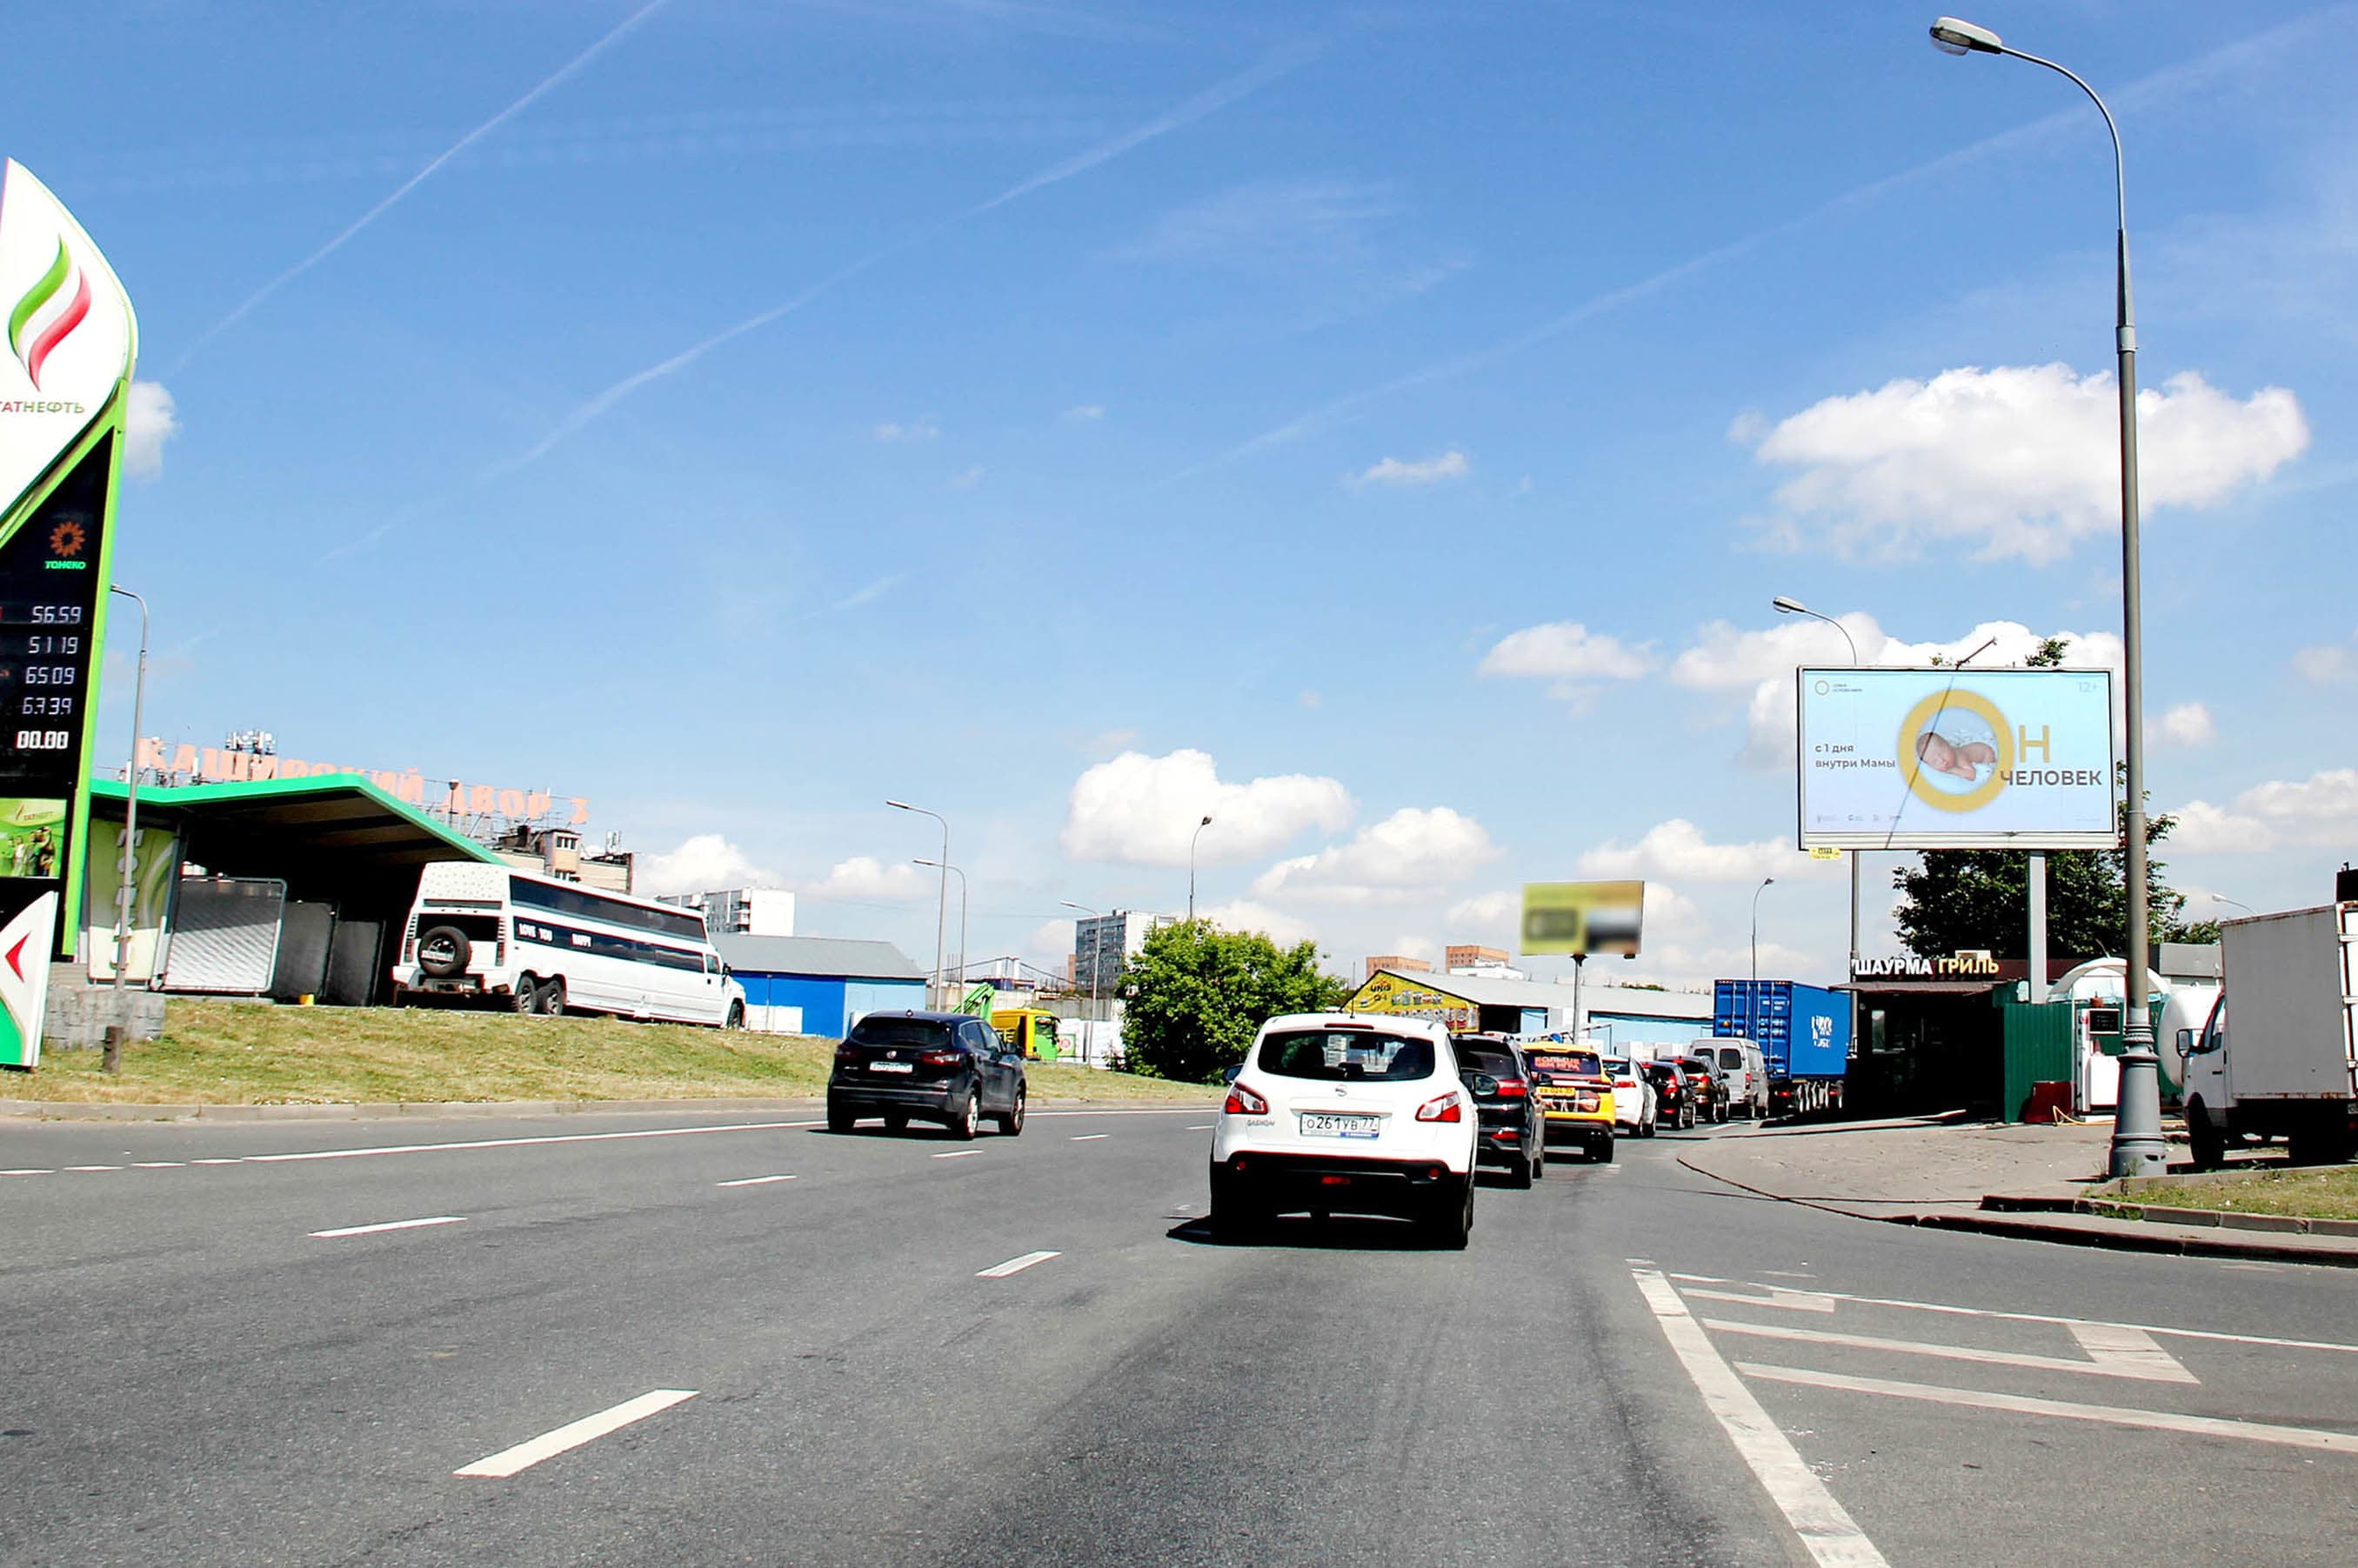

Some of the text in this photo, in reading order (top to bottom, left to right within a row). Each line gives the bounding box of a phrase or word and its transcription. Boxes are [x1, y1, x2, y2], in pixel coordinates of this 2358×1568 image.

[17, 731, 69, 750] 00.00
[1815, 758, 1896, 770] внутри Мамы
[2001, 771, 2102, 786] ЧЕЛОВЕК
[570, 797, 590, 824] 3
[1854, 958, 2001, 975] ШАУРМА ГРИЛЬ
